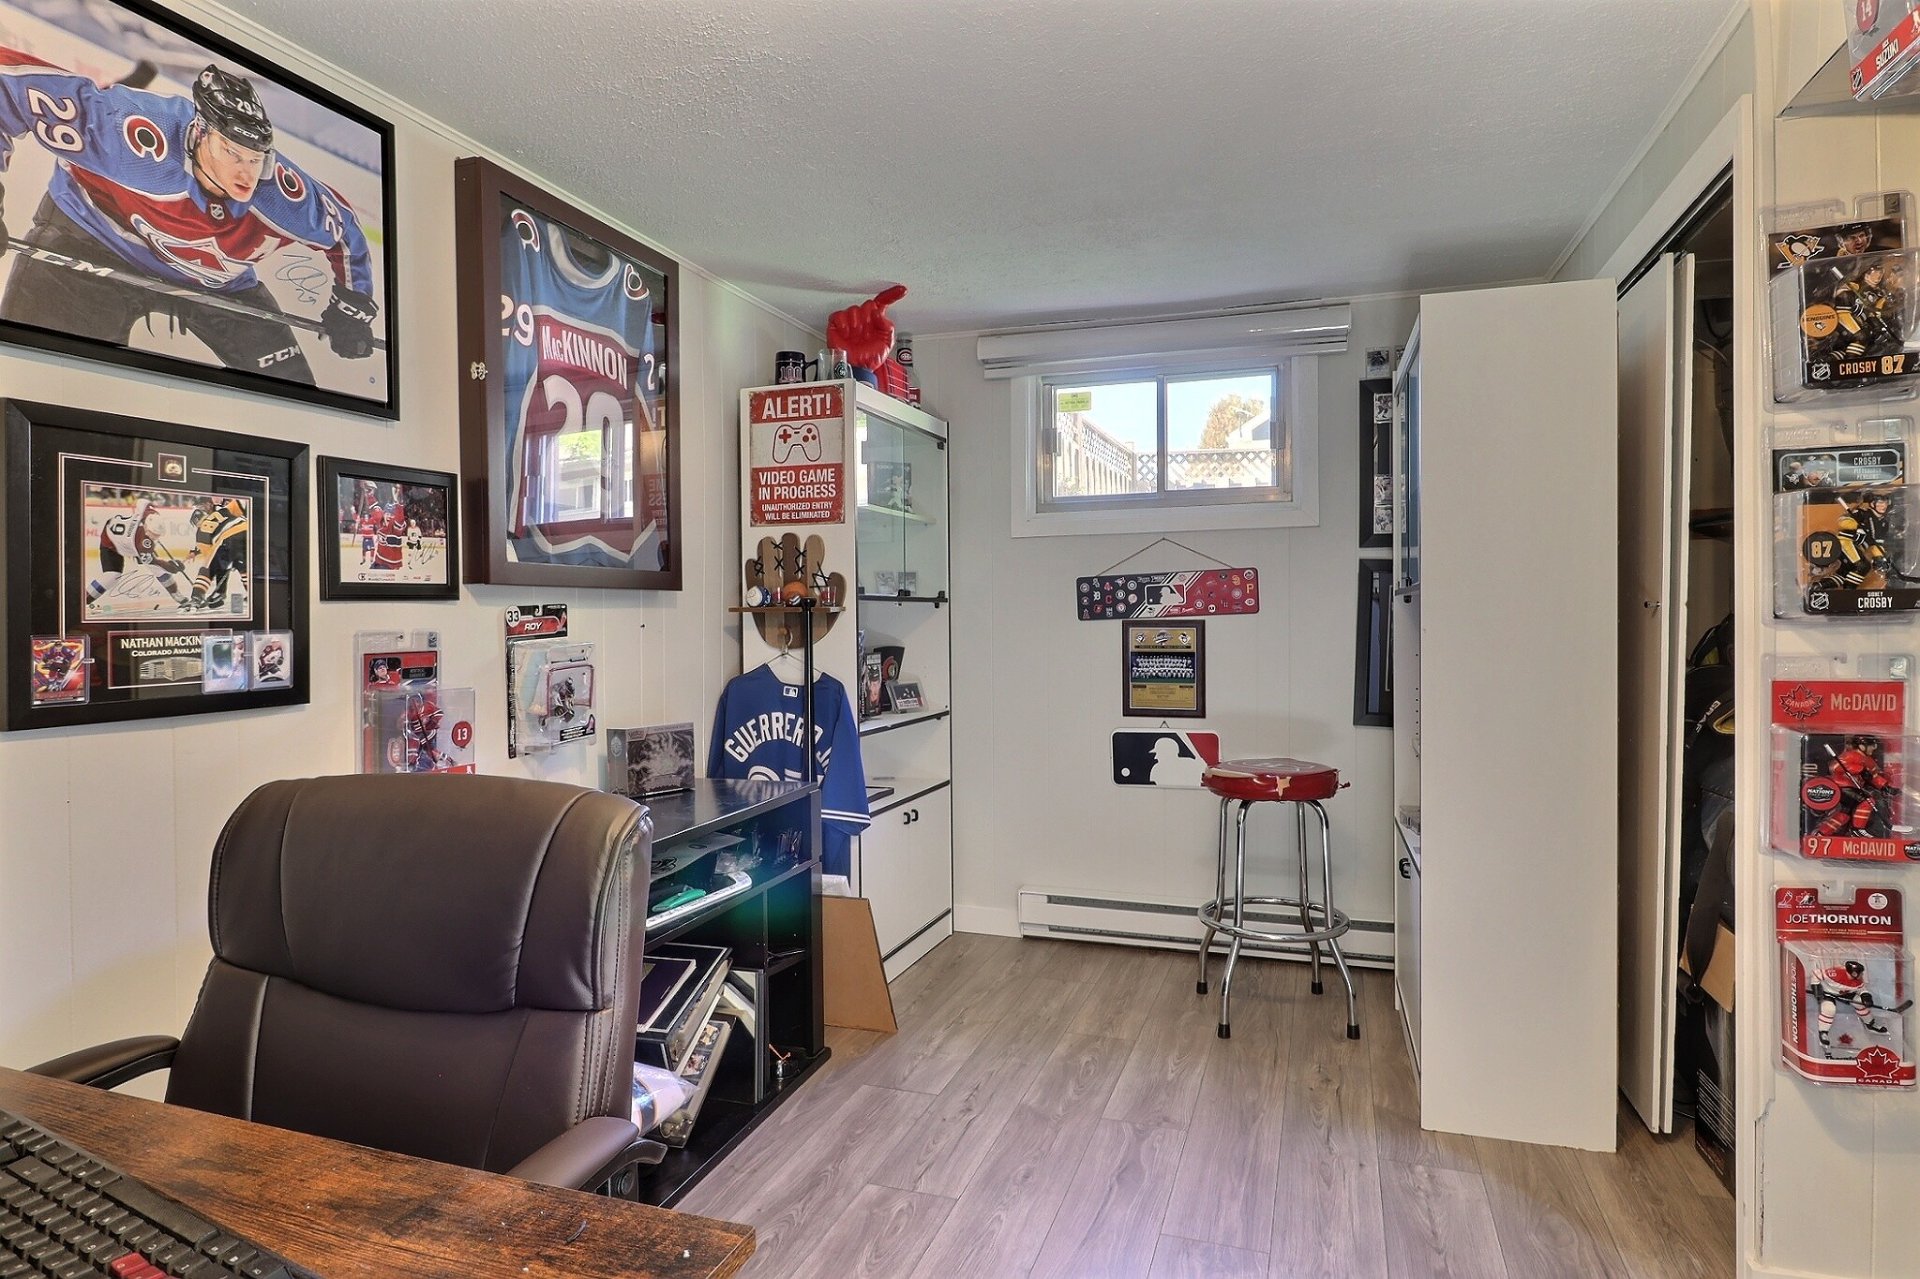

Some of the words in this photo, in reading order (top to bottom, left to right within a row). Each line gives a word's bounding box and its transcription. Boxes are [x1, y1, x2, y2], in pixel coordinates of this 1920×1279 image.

[235, 97, 253, 116] 29
[233, 126, 259, 139] CCM
[1839, 360, 1877, 376] CROSBY
[1881, 354, 1905, 375] 87
[761, 393, 831, 420] ALERT!
[1853, 456, 1882, 466] CROSBY
[759, 470, 796, 485] VIDEO
[799, 468, 836, 484] GAME
[758, 487, 770, 500] IN
[773, 483, 837, 500] PROGRESS
[761, 502, 811, 512] UNAUTHORIZED
[811, 501, 834, 511] ENTRY
[764, 512, 781, 521] WILL
[781, 511, 791, 520] BE
[791, 510, 830, 519] ELIMINATED
[1811, 541, 1833, 559] 87
[1857, 597, 1893, 608] CROSBY
[507, 611, 520, 623] 33
[524, 622, 543, 631] ROY
[121, 637, 165, 649] NATHAN
[164, 635, 202, 648] MACKIN
[1785, 698, 1815, 708] CANADA
[1830, 693, 1897, 711] McDAVID
[457, 727, 468, 740] 13
[1807, 837, 1832, 855] 97
[1842, 840, 1896, 857] McDAVID
